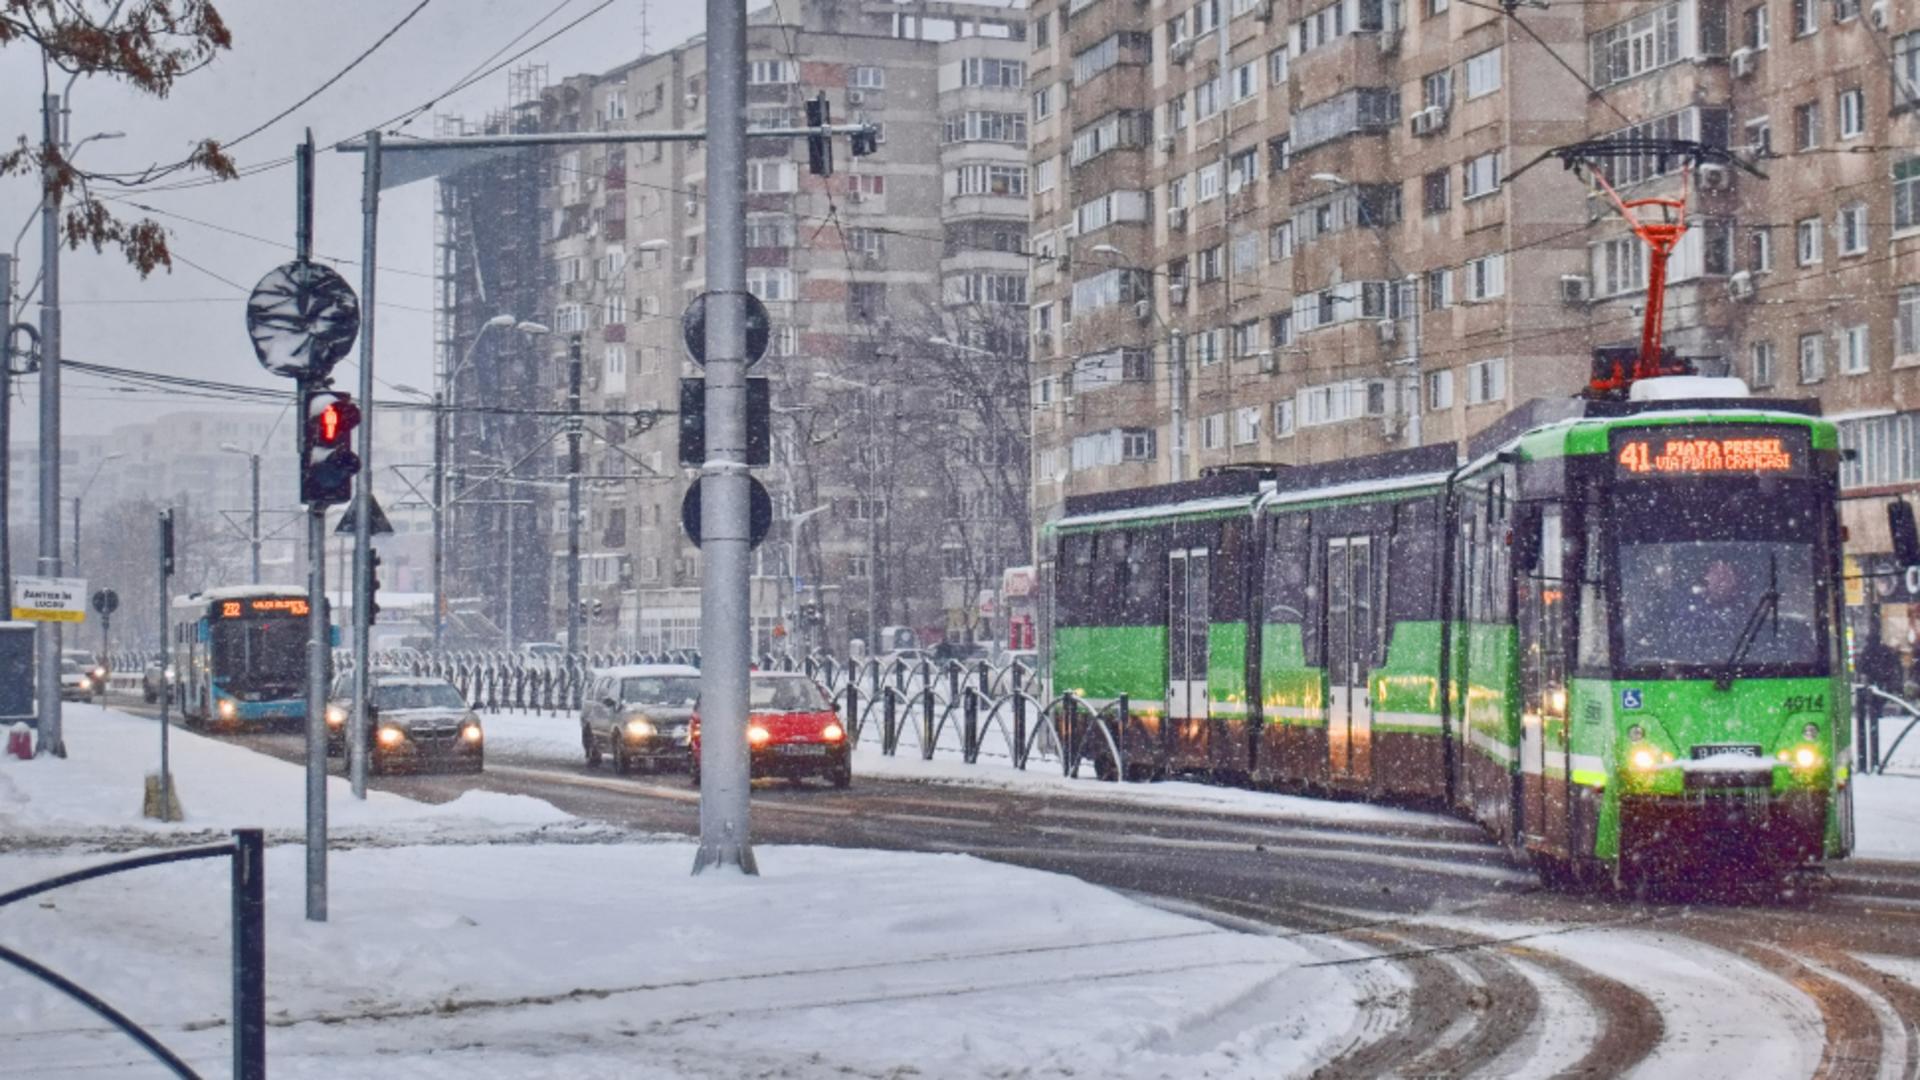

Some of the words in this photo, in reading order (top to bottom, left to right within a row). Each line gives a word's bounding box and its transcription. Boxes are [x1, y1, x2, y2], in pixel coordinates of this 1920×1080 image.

[1666, 440, 1720, 456] PIATA
[1723, 438, 1781, 455] PRESEI
[1620, 442, 1650, 472] 41
[1656, 455, 1679, 471] VIA
